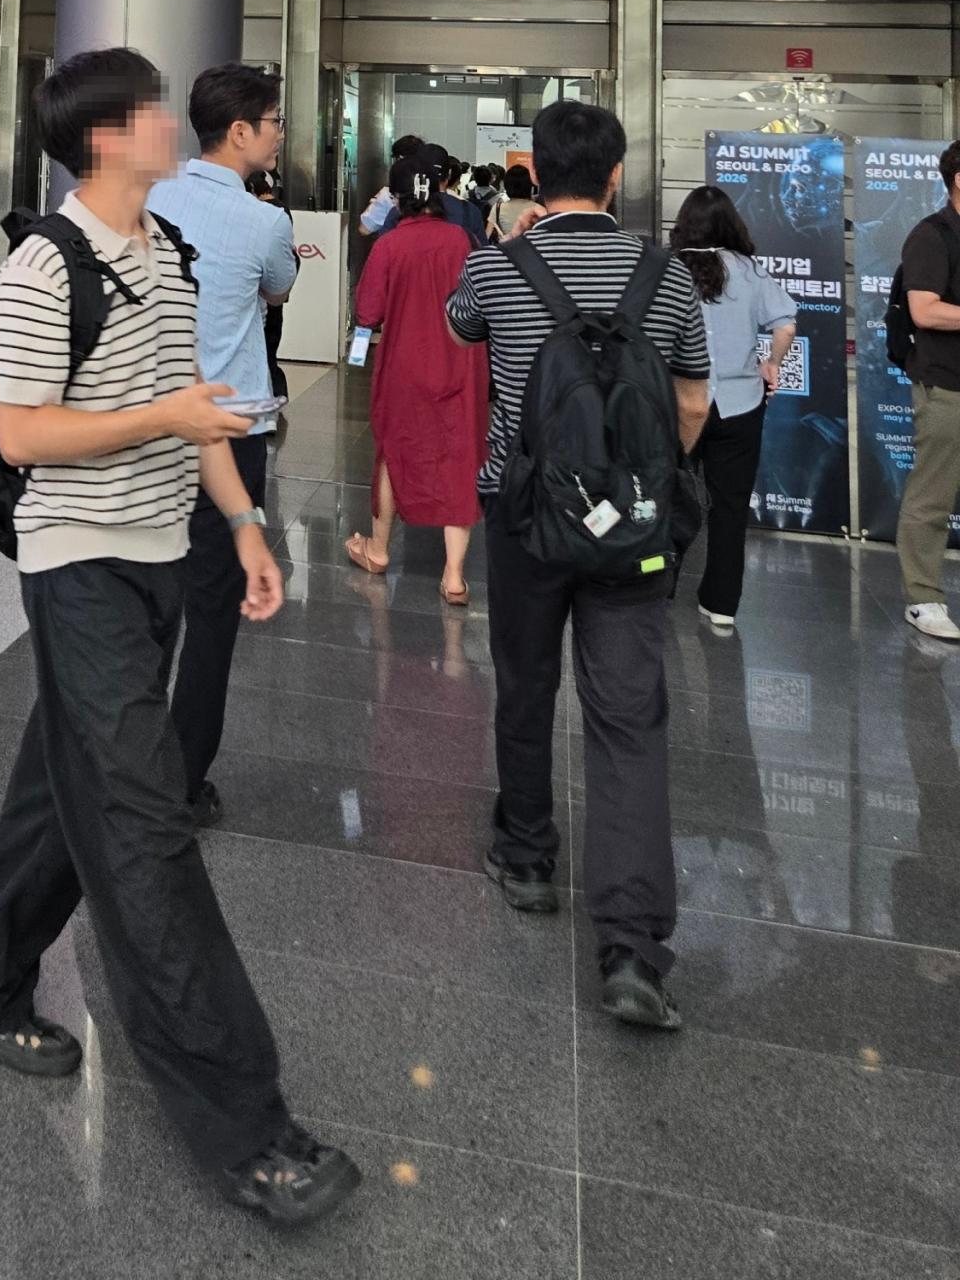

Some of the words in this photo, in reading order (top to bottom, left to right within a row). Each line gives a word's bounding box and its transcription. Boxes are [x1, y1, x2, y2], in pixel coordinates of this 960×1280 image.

[716, 145, 736, 158] AI
[739, 146, 811, 161] SUMMIT
[865, 152, 885, 166] AI
[889, 153, 940, 168] SUMM
[716, 160, 760, 172] SEOUL
[761, 162, 772, 173] &
[775, 163, 812, 174] EXPO
[716, 172, 748, 184] 2026
[865, 168, 911, 179] SEOUL
[913, 170, 925, 180] &
[927, 170, 943, 181] EX
[865, 180, 899, 192] 2026
[751, 255, 811, 276] 가기업
[878, 404, 903, 413] EXPO
[883, 414, 904, 423] may
[876, 433, 913, 443] SUMMIT
[890, 451, 911, 460] both
[896, 460, 915, 469] Gra
